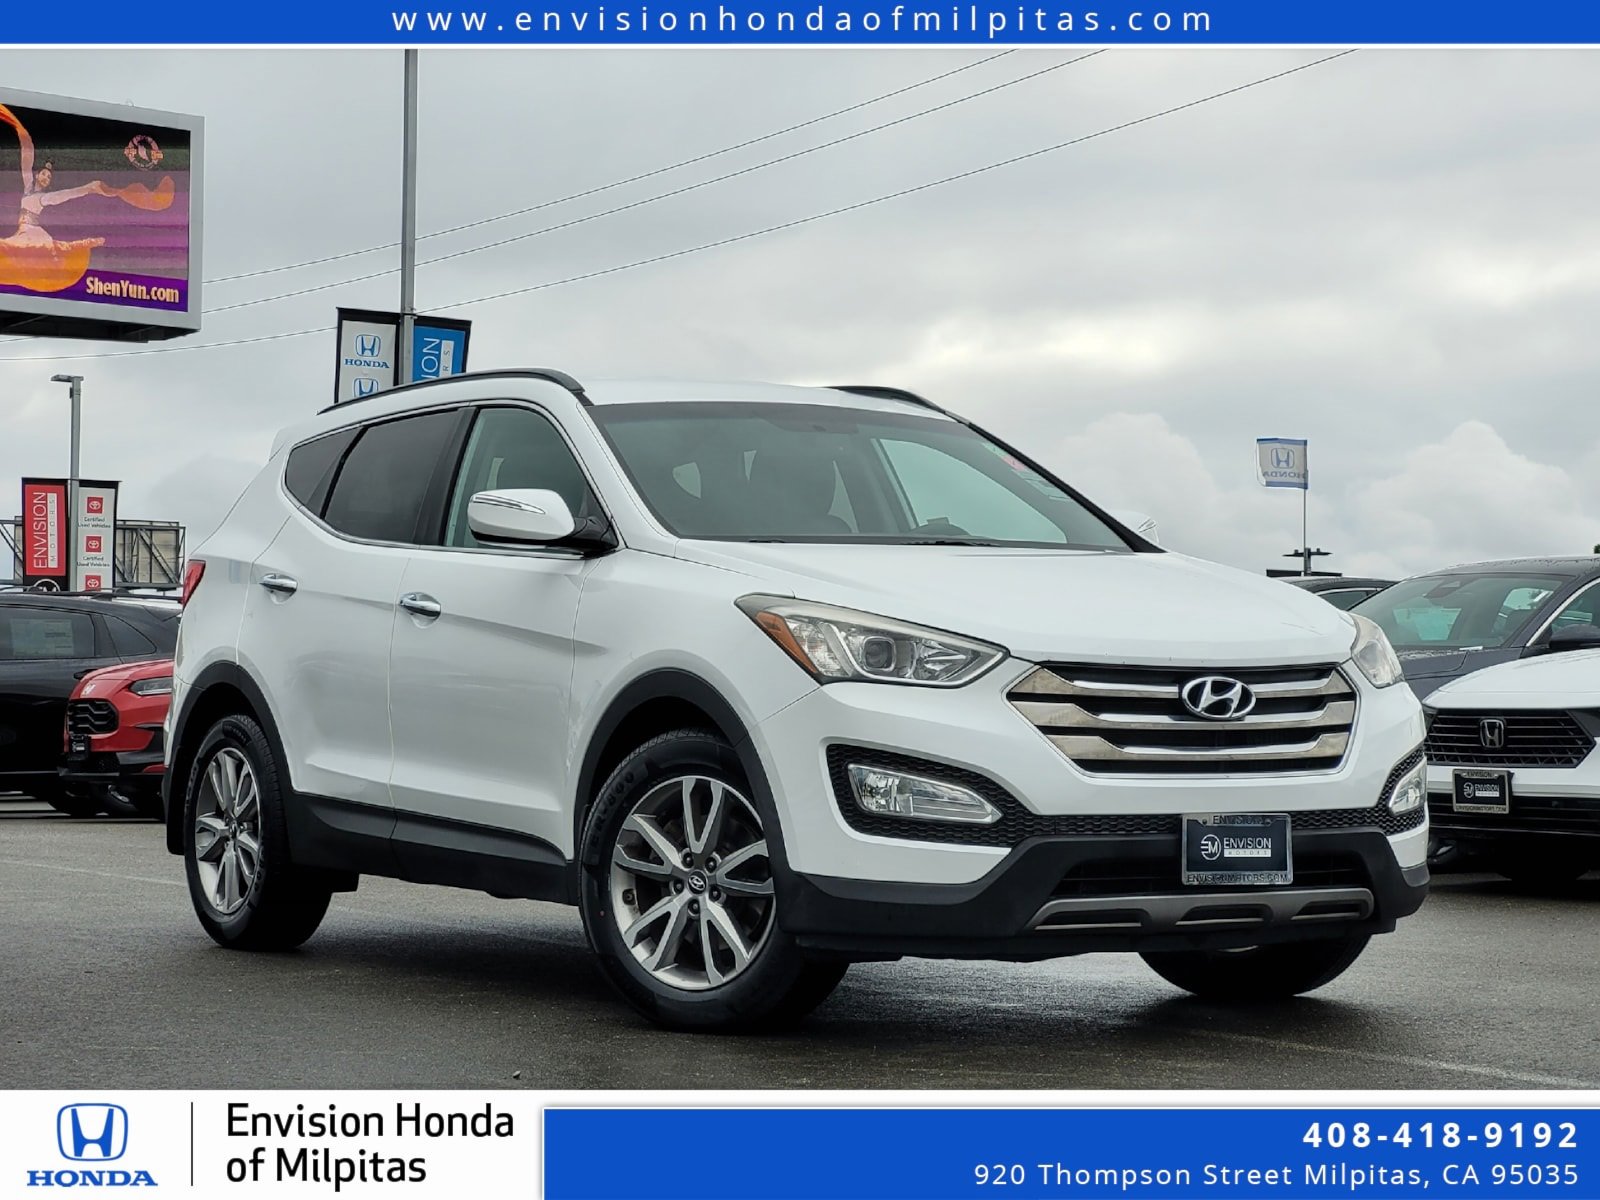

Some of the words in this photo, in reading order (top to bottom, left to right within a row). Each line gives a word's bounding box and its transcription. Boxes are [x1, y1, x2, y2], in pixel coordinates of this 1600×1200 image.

[85, 277, 179, 303] ShenYun.com
[344, 358, 390, 369] HONDA
[33, 492, 47, 568] ENVISION
[1223, 837, 1272, 849] ENVISION
